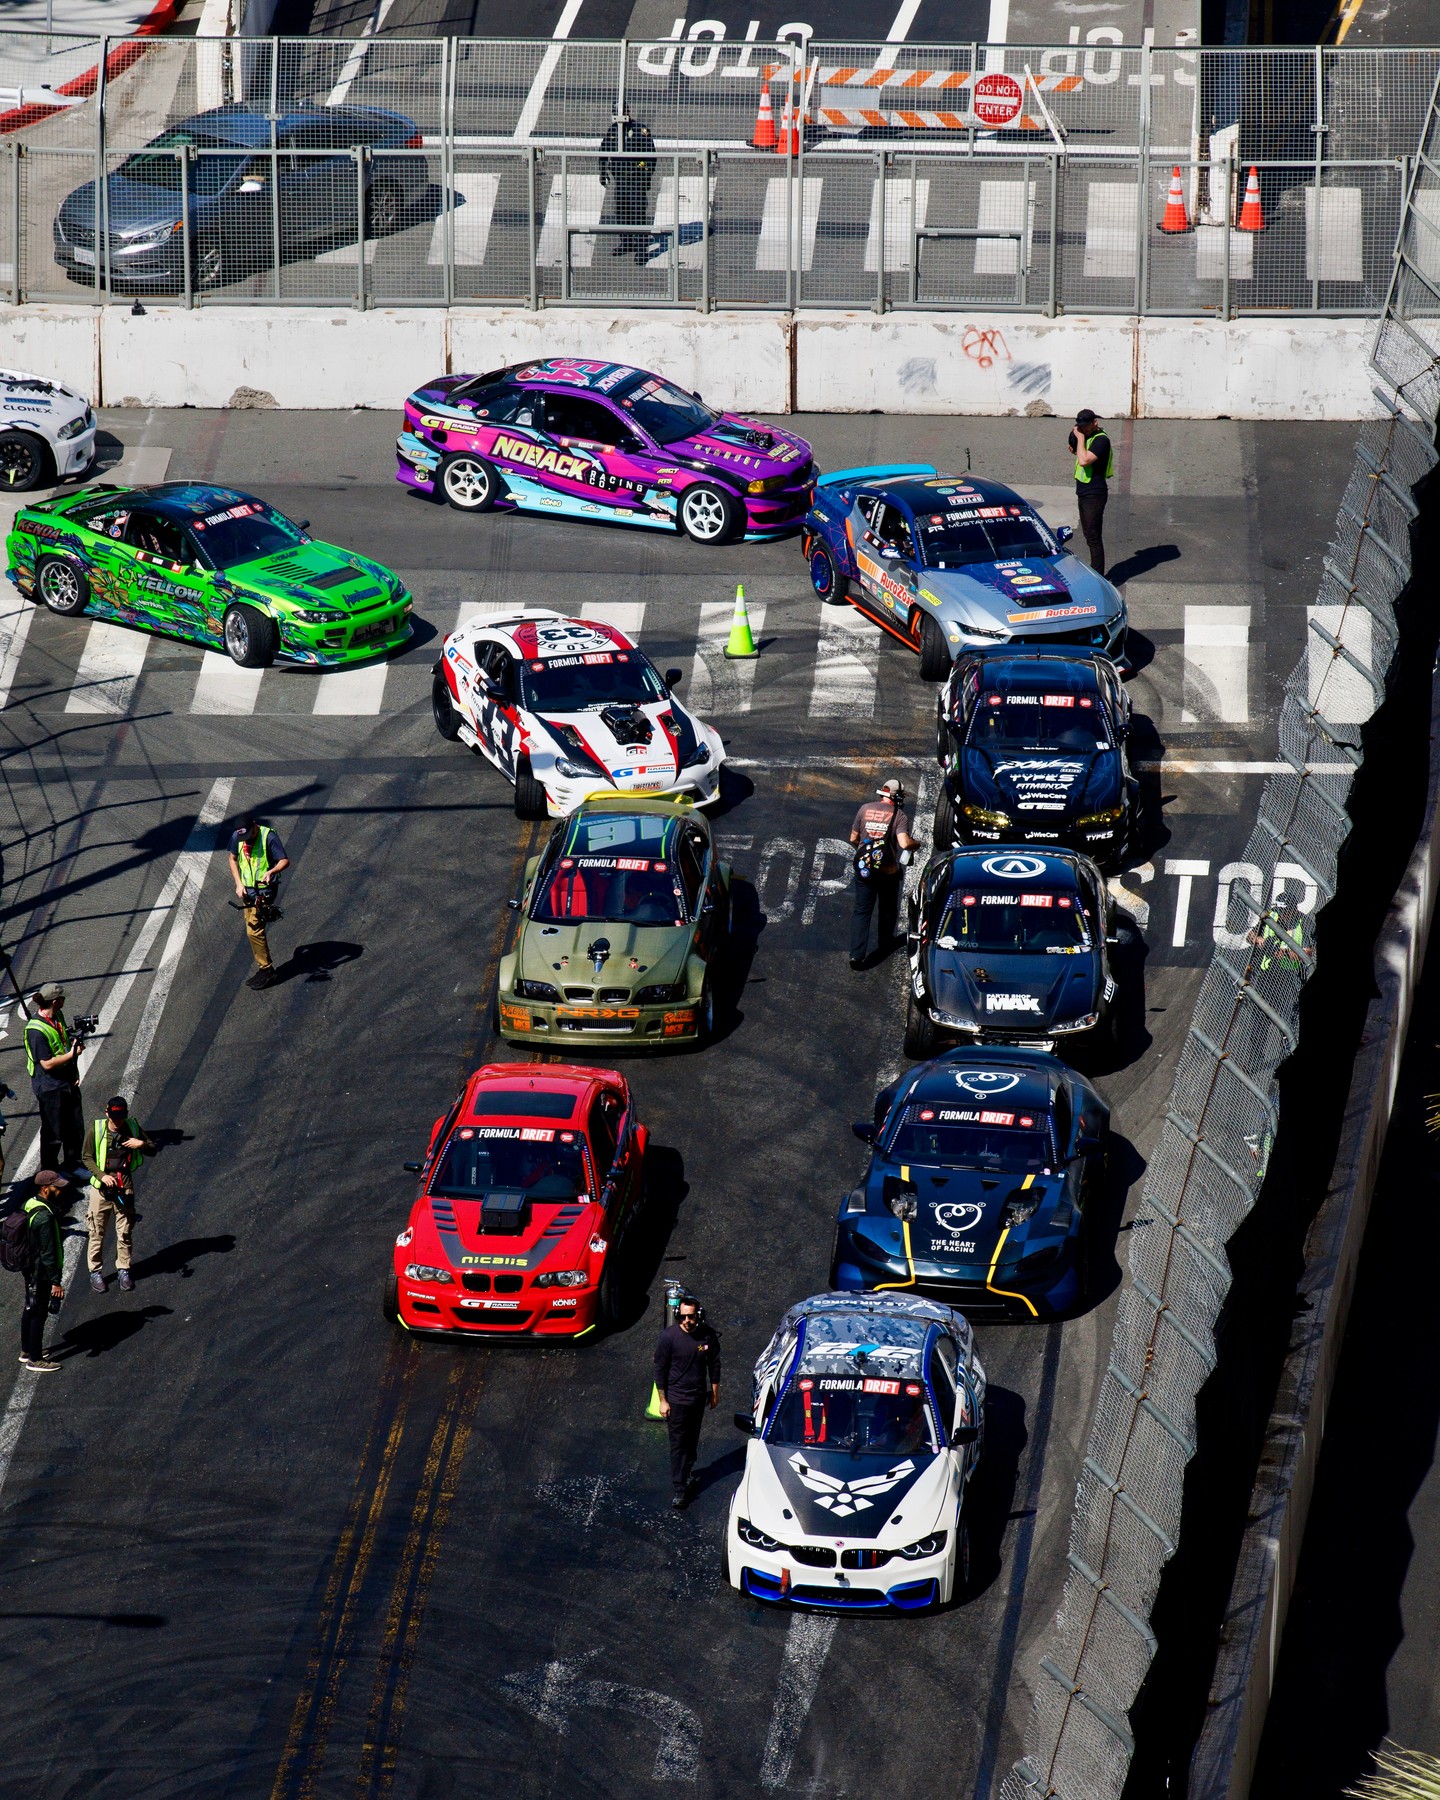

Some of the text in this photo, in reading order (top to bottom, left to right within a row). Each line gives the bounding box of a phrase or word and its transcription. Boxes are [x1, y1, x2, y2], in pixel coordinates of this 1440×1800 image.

[979, 84, 1017, 95] DO NOT
[979, 105, 1013, 116] ENTER
[451, 423, 479, 432] RADIAL
[491, 435, 591, 481] NOBACK
[589, 477, 612, 491] CO.
[590, 469, 643, 492] RACING
[205, 511, 235, 526] FORMULA
[946, 507, 1005, 521] FORMULA DRIFT
[18, 518, 62, 540] KENDA
[948, 518, 994, 529] MUSTANG
[137, 573, 204, 600] YELLOW
[1045, 605, 1097, 618] AutoZone
[539, 627, 592, 641] 33
[548, 653, 612, 669] FORMULA DRIFT
[1007, 696, 1073, 707] FORMULA DRIFT
[612, 766, 647, 778] GT
[578, 858, 648, 871] FORMULA DRIFT
[981, 895, 1051, 906] FORMULA DRIFT
[986, 998, 1041, 1011] MAX
[939, 1110, 1013, 1125] FORMULA DRIFT
[479, 1128, 554, 1142] FORMULA DRIFT
[931, 1239, 976, 1248] THE HEART
[461, 1255, 528, 1266] nicalis
[552, 1298, 577, 1307] KÖNIG
[819, 1379, 899, 1394] FORMULA DRIFT
